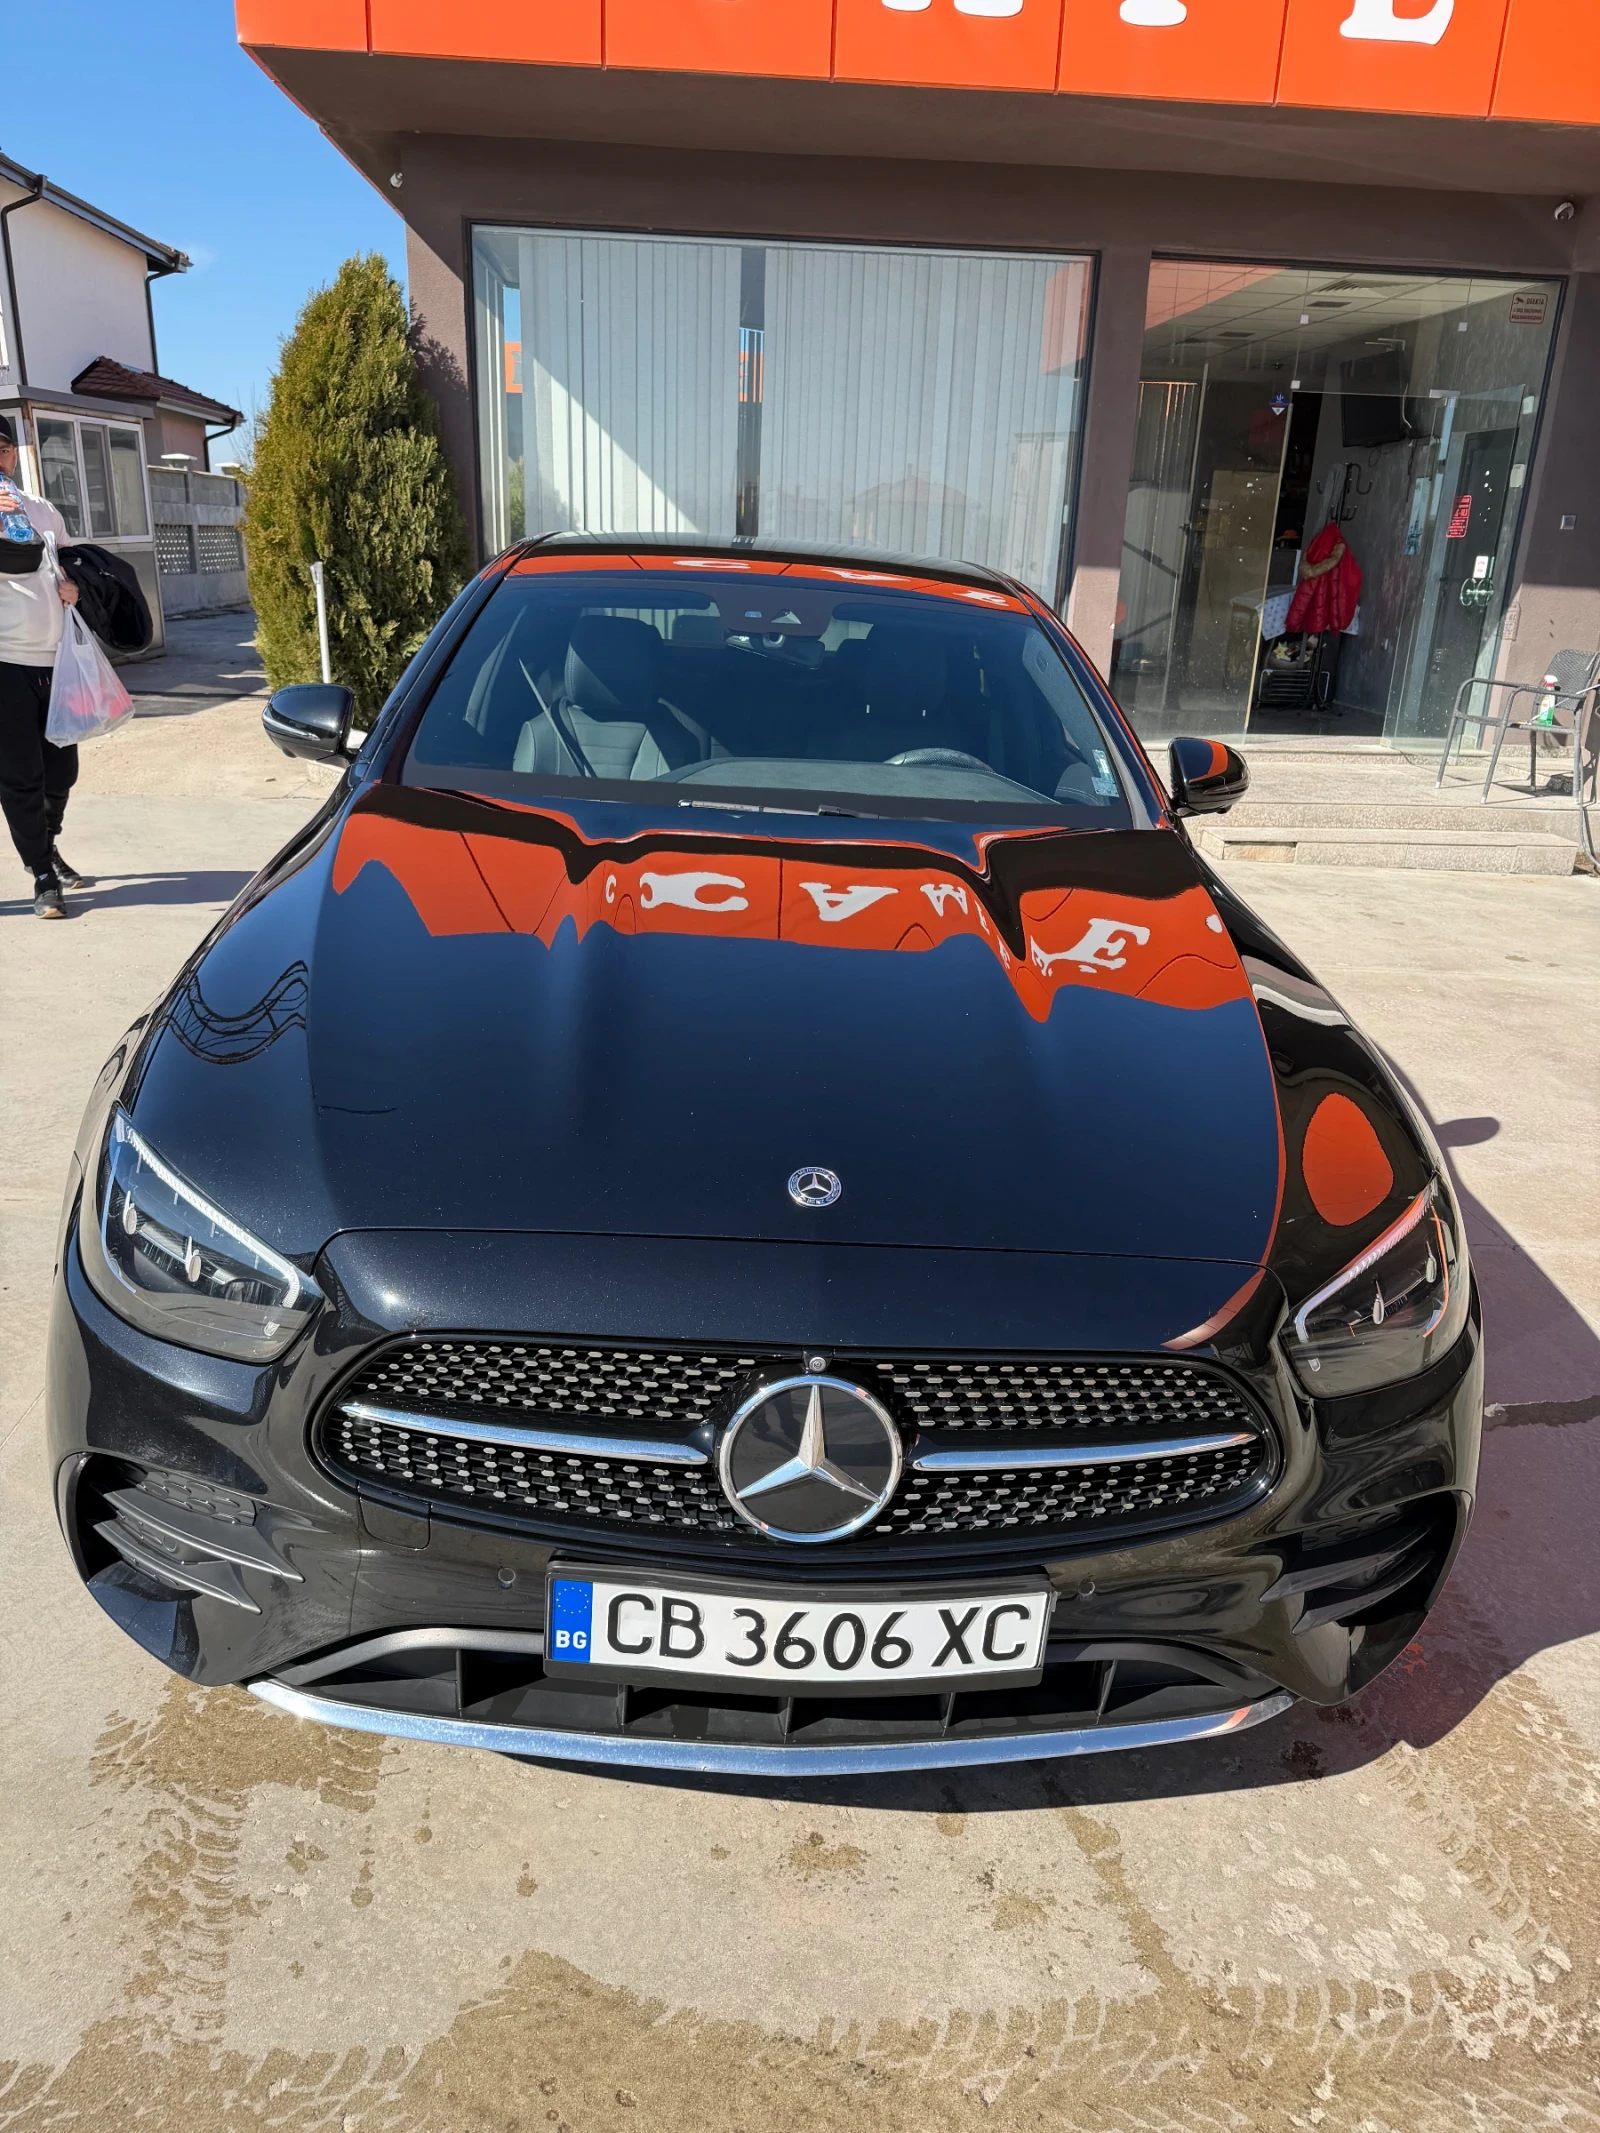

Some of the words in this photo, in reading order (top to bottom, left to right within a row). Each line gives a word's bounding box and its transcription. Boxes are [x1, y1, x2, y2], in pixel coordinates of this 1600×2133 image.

[555, 1629, 588, 1649] BG
[607, 1593, 705, 1659] CB
[724, 1606, 914, 1671] 3606
[931, 1604, 1032, 1668] XC
